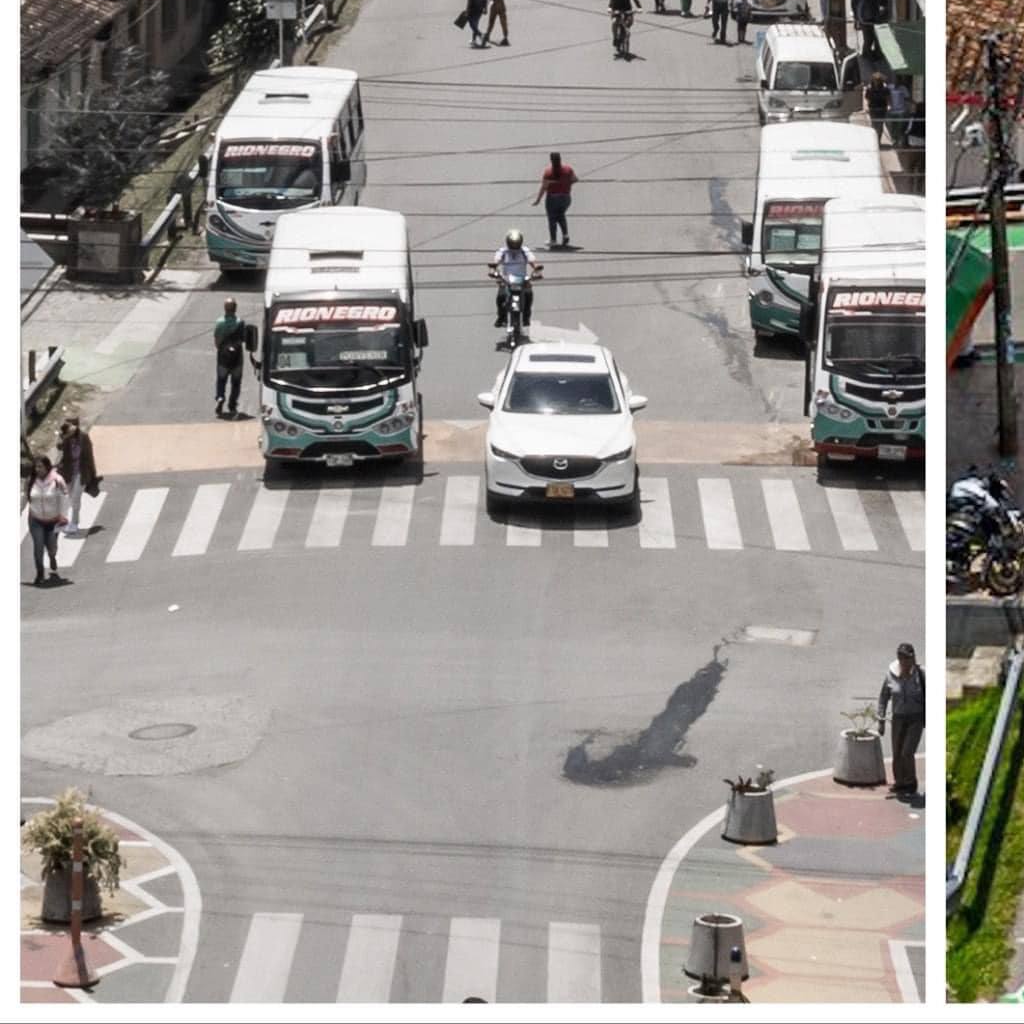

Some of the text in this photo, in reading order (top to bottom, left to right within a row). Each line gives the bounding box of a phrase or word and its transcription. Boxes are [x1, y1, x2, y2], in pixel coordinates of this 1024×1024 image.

[224, 144, 316, 158] RIONEGRO
[833, 291, 926, 308] RIONEG
[274, 305, 397, 323] RIONEGRO
